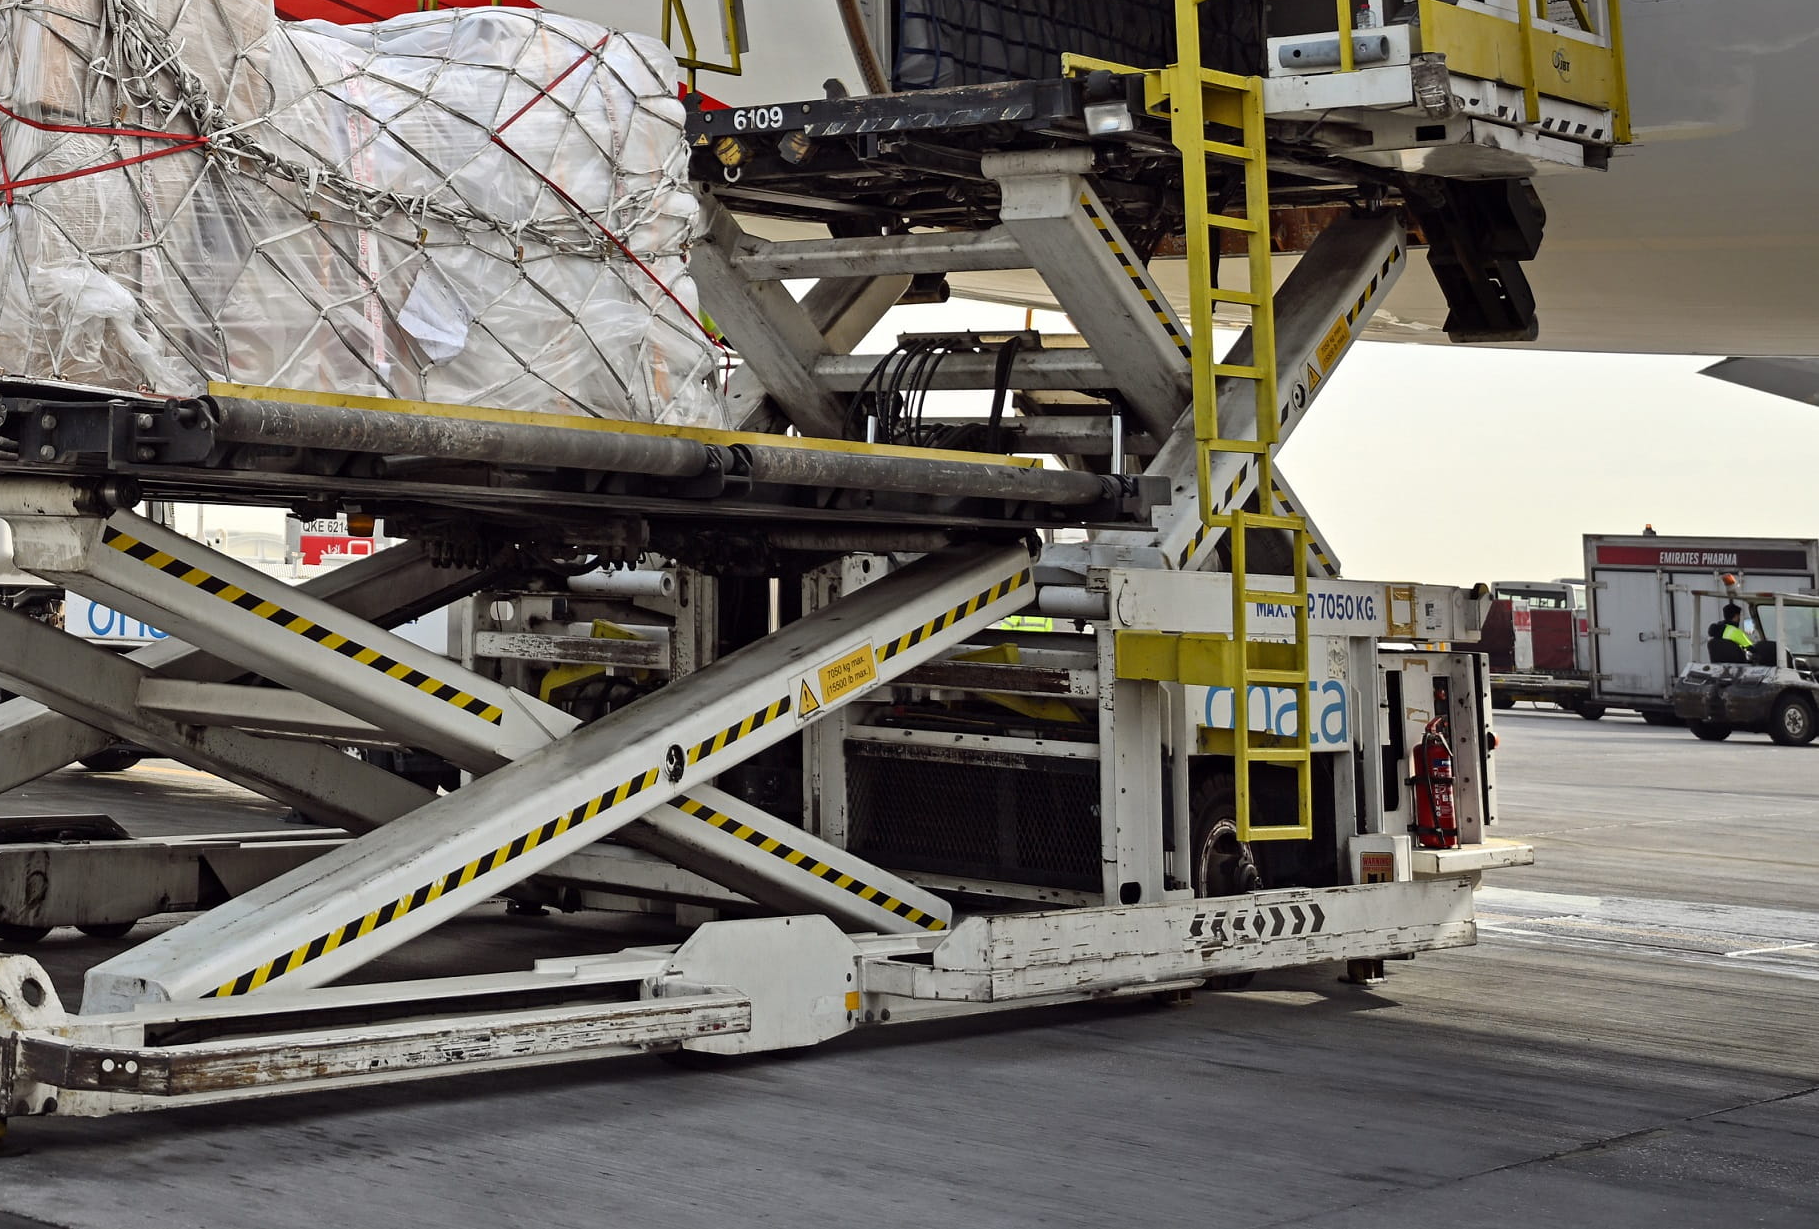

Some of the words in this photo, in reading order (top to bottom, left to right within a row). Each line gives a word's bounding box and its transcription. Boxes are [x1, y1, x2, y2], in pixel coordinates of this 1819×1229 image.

[1560, 60, 1571, 72] JBT
[733, 106, 784, 131] 6109
[302, 521, 325, 533] QKE
[1659, 551, 1699, 565] EMIRATES
[1701, 552, 1737, 566] PHARMA
[1318, 593, 1354, 620] 7050
[1356, 595, 1377, 621] KG.
[827, 665, 842, 680] 7050
[843, 662, 851, 672] kg
[826, 677, 848, 697] (15500
